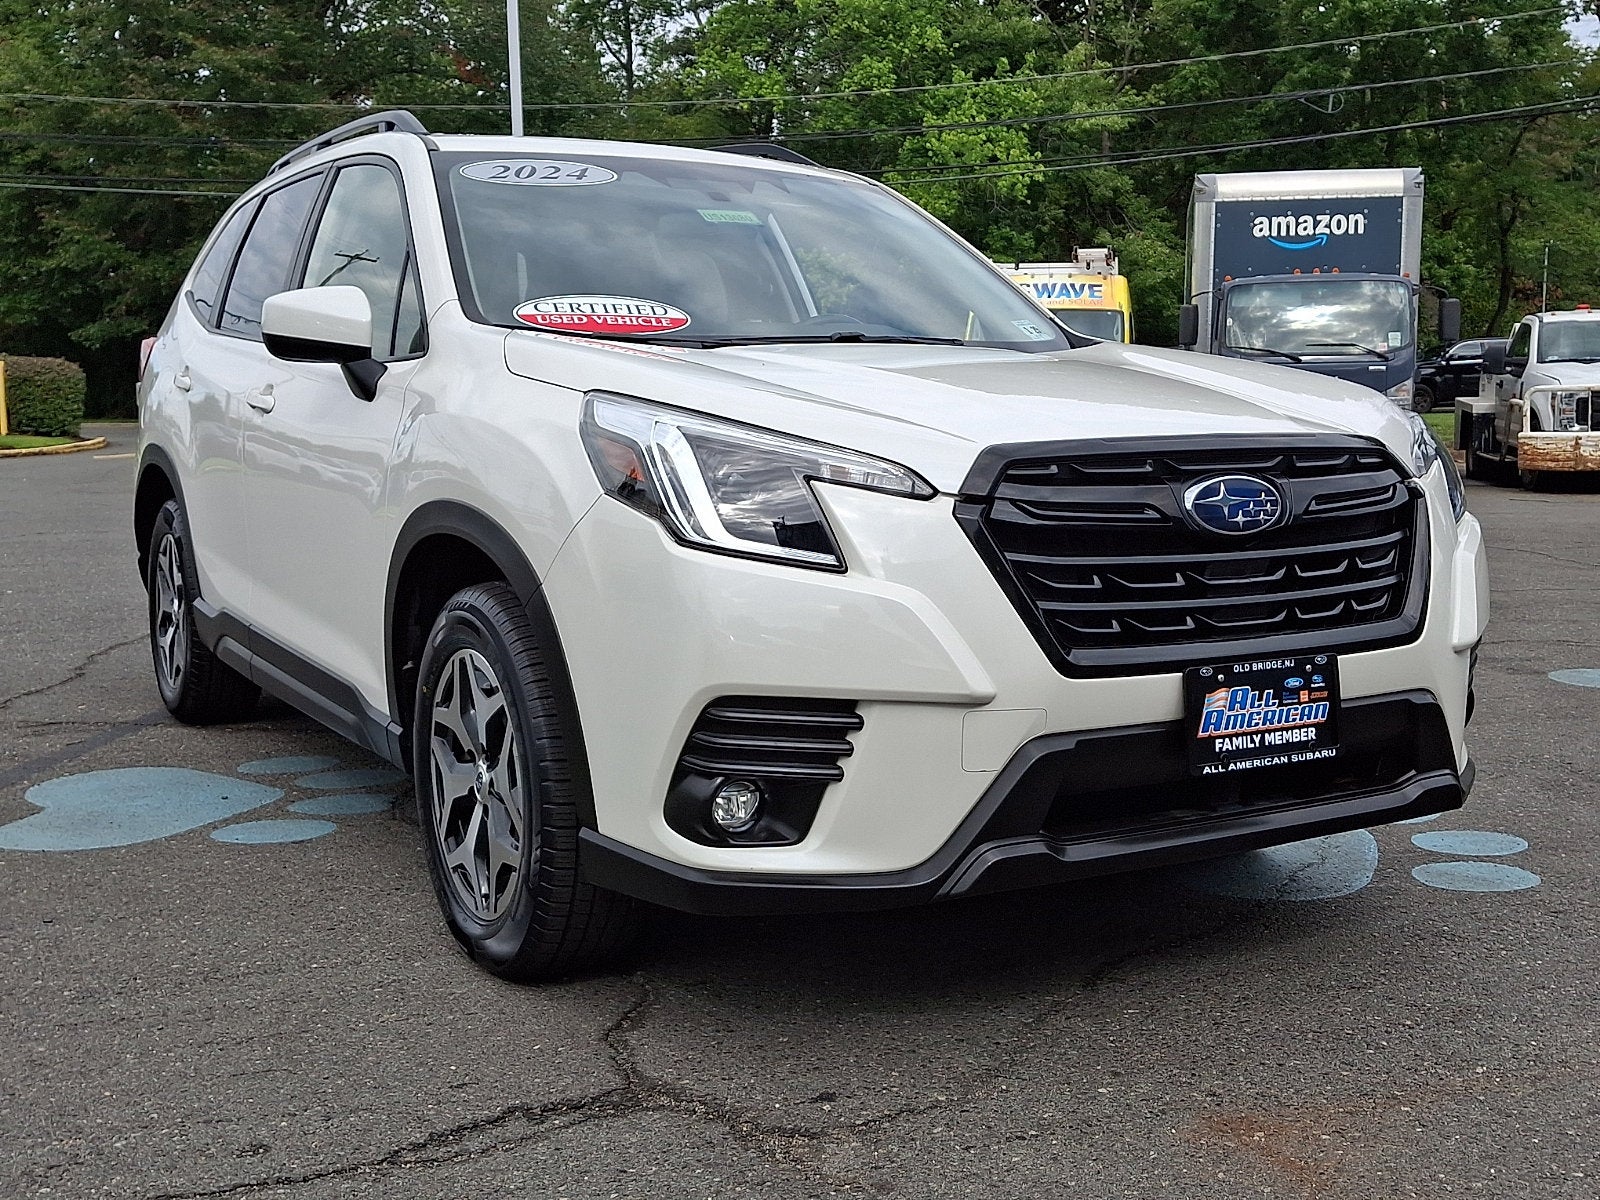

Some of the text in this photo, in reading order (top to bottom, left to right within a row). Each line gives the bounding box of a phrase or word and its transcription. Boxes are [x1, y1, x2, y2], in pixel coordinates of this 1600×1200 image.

[488, 165, 589, 180] 2024
[1252, 213, 1365, 238] amazon
[533, 302, 668, 316] CERTIFIED
[535, 315, 673, 327] USED VEHICLE
[1233, 659, 1295, 673] OLD BRIDGE,NJ
[1228, 686, 1279, 712] ALL
[1199, 702, 1329, 736] AMERICAN
[1215, 727, 1316, 752] FAMILY MEMBER
[1203, 749, 1336, 775] ALL AMERICAN SUBARU
